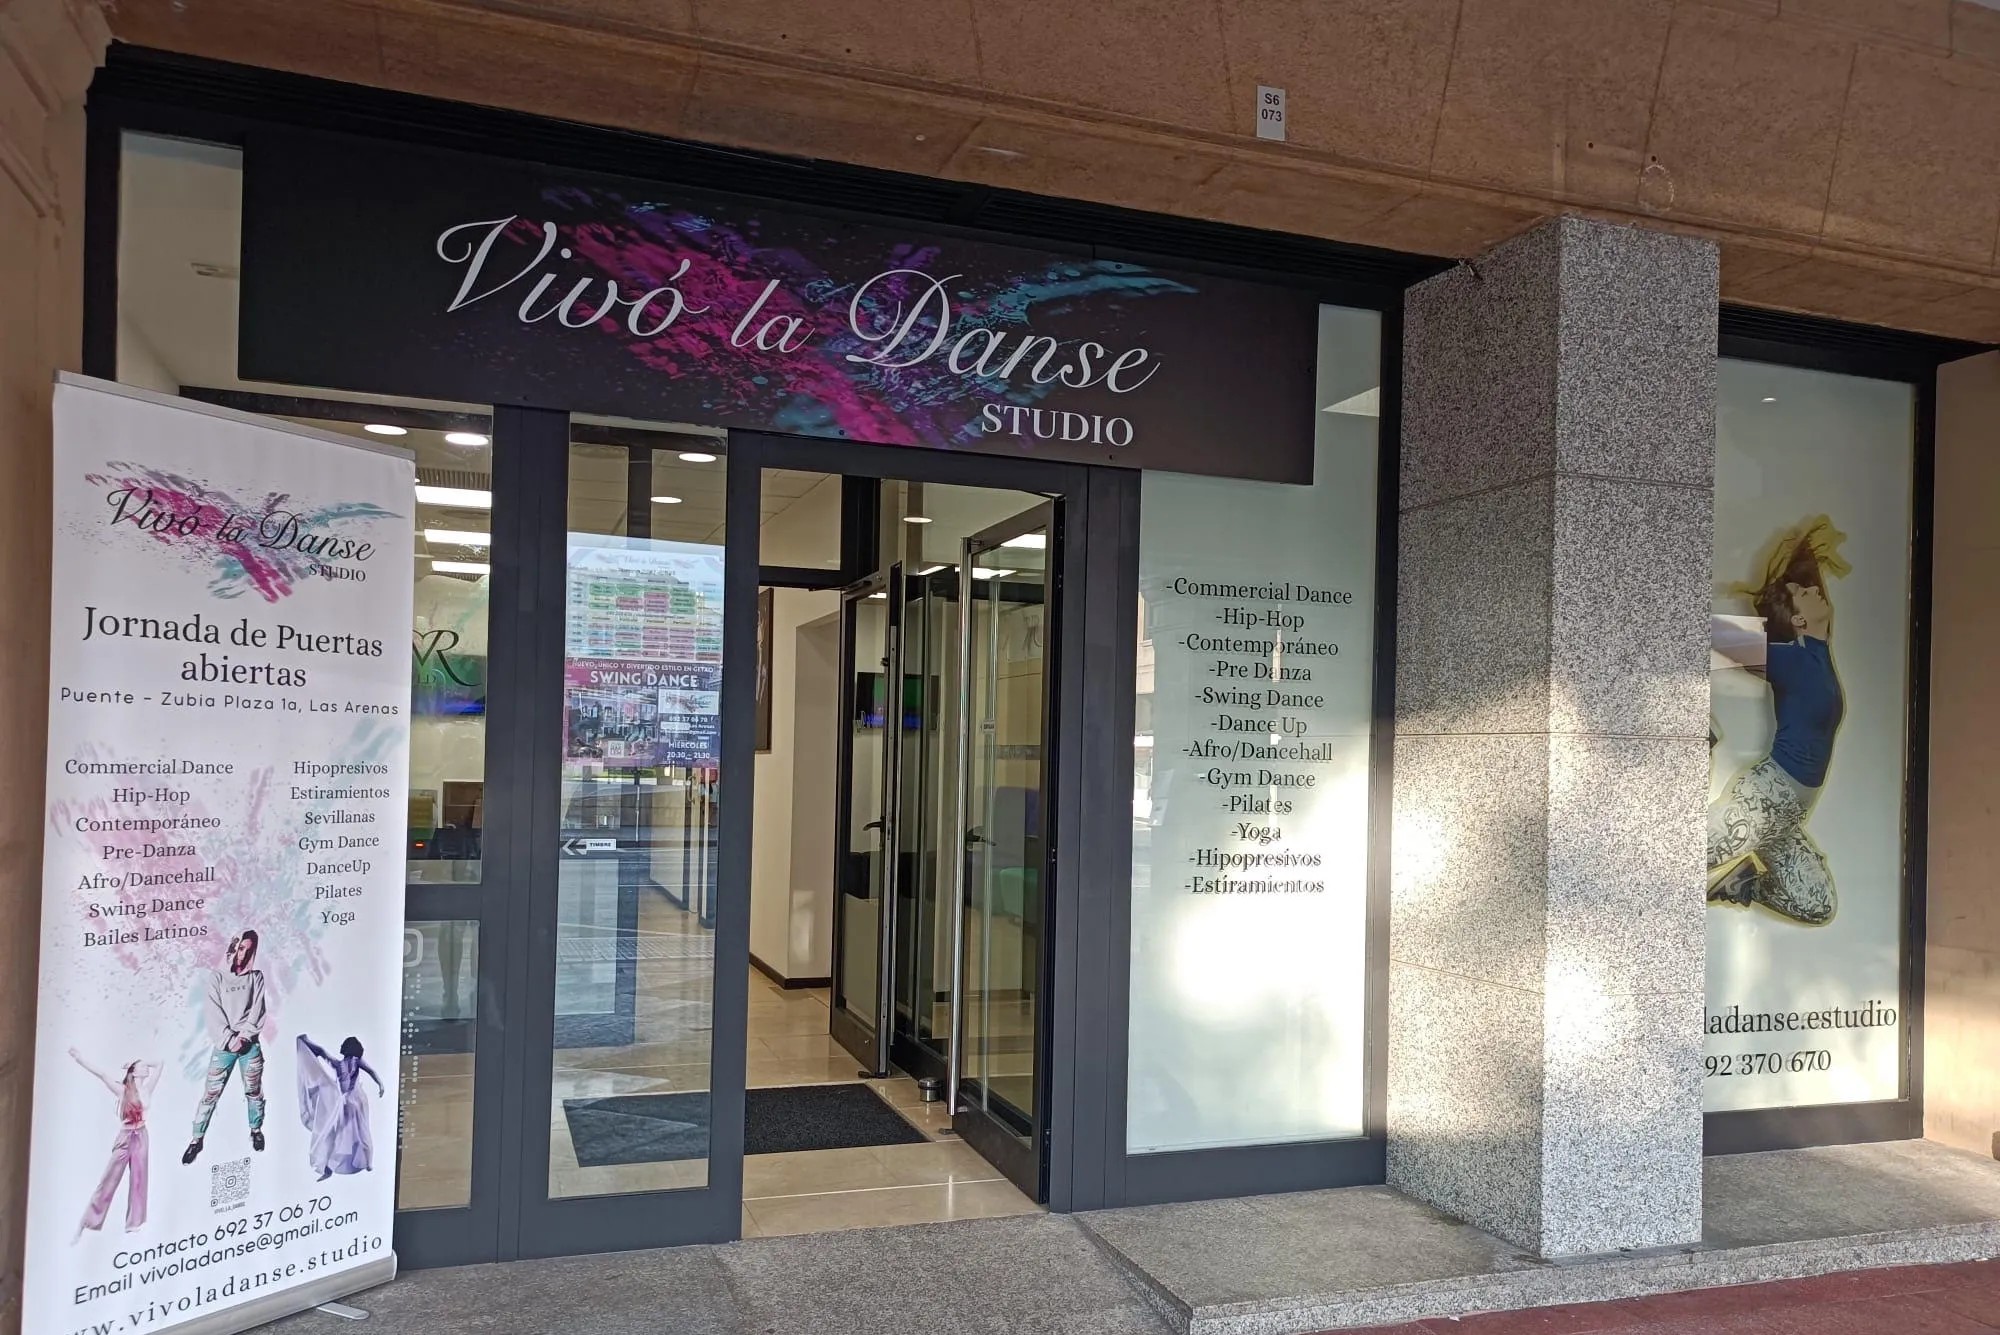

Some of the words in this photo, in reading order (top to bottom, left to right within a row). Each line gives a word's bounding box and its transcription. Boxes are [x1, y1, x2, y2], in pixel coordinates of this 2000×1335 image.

[1264, 93, 1280, 105] S6
[1261, 108, 1282, 122] 073
[436, 214, 709, 336] Vivó
[730, 280, 814, 354] la
[846, 269, 1162, 394] Danse
[981, 404, 1134, 447] STUDIO
[107, 486, 209, 535] Vivó
[217, 513, 249, 544] la
[259, 510, 376, 562] Danse
[309, 562, 366, 582] STUDIO
[1166, 577, 1290, 601] -Commercial
[1296, 585, 1353, 604] Dance
[1215, 607, 1305, 632] -Hip-Hop
[83, 606, 220, 645] Jornada
[230, 619, 267, 648] de
[277, 624, 383, 657] Puertas
[1178, 633, 1339, 657] -Contemporáneo
[181, 653, 307, 687] abiertas
[590, 670, 641, 685] SWING
[647, 673, 698, 688] DANCE
[1254, 663, 1312, 681] Danza
[61, 687, 134, 705] Puente
[161, 691, 216, 708] Zubia
[224, 694, 275, 711] Plaza
[281, 698, 302, 714] 1a,
[310, 700, 338, 714] Las
[344, 701, 399, 716] Arenas
[1195, 686, 1262, 709] -Swing
[1267, 690, 1324, 708] Dance
[1211, 714, 1277, 732] -Dance
[1282, 718, 1308, 737] Up
[65, 758, 177, 776] Commercial
[182, 759, 234, 775] Dance
[293, 760, 388, 778] Hipopresivos
[1199, 768, 1252, 790] -Gym
[1258, 769, 1316, 787] Dance
[113, 787, 190, 806] Hip-Hop
[291, 784, 390, 801] Estiramientos
[1222, 794, 1292, 813] -Pilates
[75, 814, 221, 834] Contemporáneo
[304, 810, 375, 826] Sevillanas
[103, 843, 196, 861] Pre-Danza
[299, 836, 334, 853] Gym
[338, 834, 380, 850] Dance
[78, 867, 215, 891] Afro/Dancehall
[306, 859, 372, 877] DanceUp
[315, 884, 363, 900] Pilates
[89, 900, 147, 920] Swing
[152, 897, 205, 914] Dance
[321, 909, 356, 927] Yoga
[84, 929, 140, 948] Bailes
[144, 923, 208, 942] Latinos
[1704, 1000, 1897, 1034] ladanse.estudio
[1705, 1055, 1732, 1077] 92
[1741, 1052, 1782, 1075] 370
[1791, 1049, 1832, 1072] 670
[113, 1231, 209, 1270] Contacto
[214, 1219, 248, 1242] 692
[253, 1211, 274, 1232] 37
[278, 1204, 304, 1223] 06
[309, 1196, 332, 1215] 70
[74, 1272, 133, 1305] Email
[139, 1209, 359, 1285] vivoladanse@gmail.com
[65, 1233, 383, 1335] w.vivoladanse.studio
